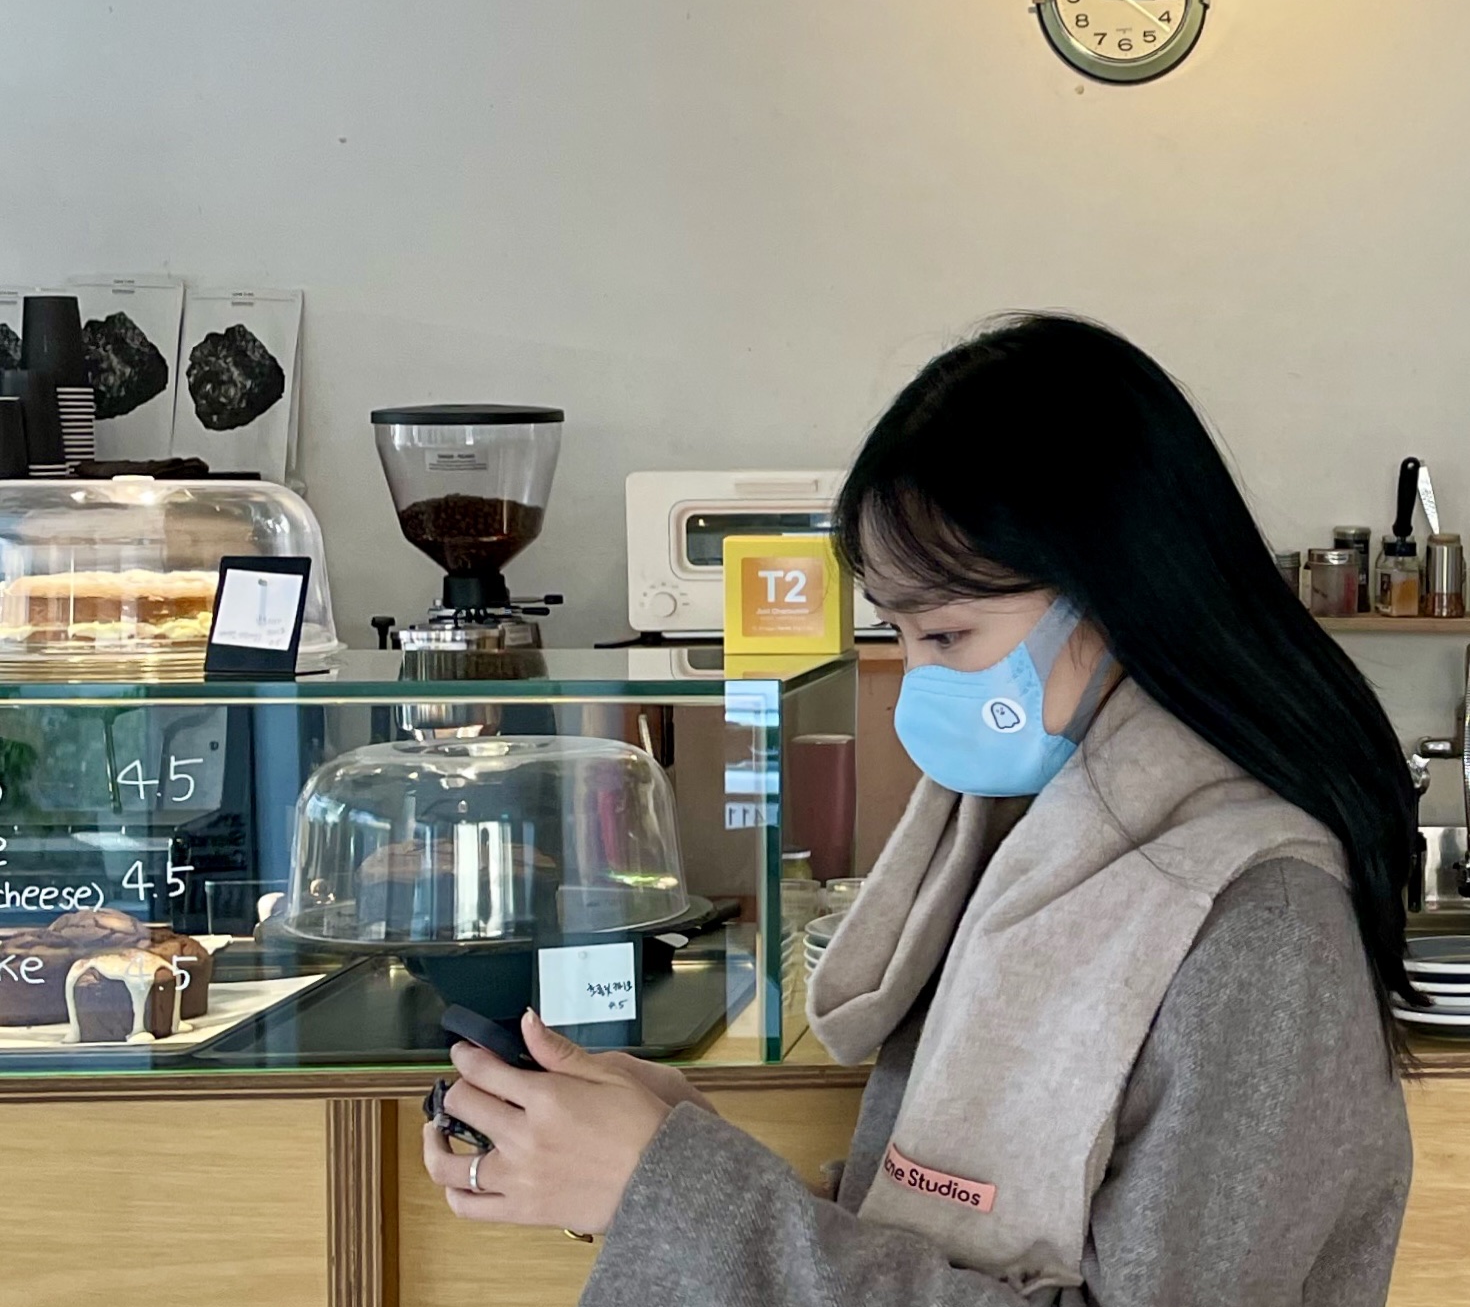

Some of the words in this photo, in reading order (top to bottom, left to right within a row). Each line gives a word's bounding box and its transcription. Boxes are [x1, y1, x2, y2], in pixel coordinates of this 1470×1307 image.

[1075, 13, 1090, 28] 8
[1158, 10, 1172, 24] 4
[1094, 32, 1107, 46] 7
[1118, 38, 1133, 52] 6
[1143, 30, 1157, 43] 5
[757, 569, 807, 603] T2
[116, 755, 205, 802] 4.5
[121, 860, 195, 901] 4.5
[125, 954, 199, 991] 4.5
[908, 1168, 982, 1206] Studios
